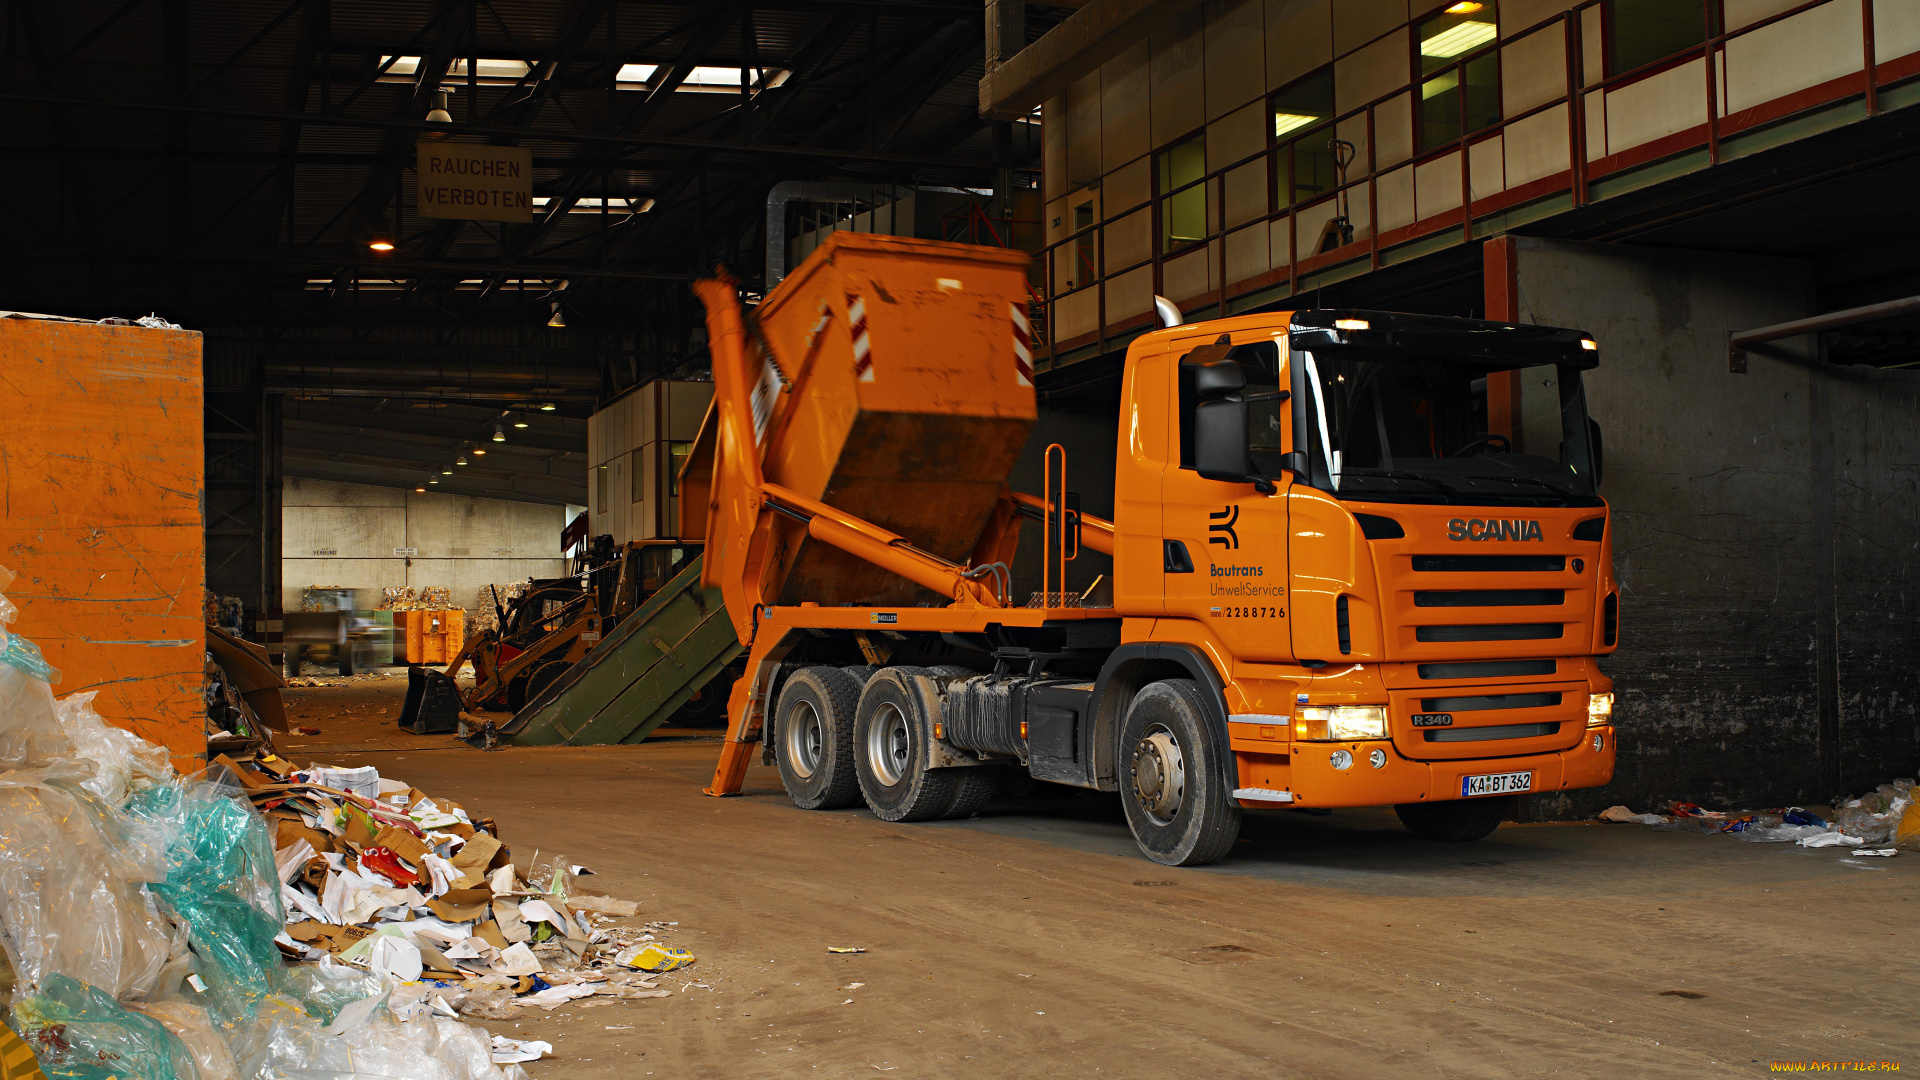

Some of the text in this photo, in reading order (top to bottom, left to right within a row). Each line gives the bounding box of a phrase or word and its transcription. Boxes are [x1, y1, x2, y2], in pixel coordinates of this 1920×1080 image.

[430, 156, 520, 178] RAUCHEN
[424, 186, 527, 209] VERBOTEN
[1446, 518, 1544, 542] SCANIA
[1210, 563, 1264, 577] Bautrans
[1210, 581, 1285, 597] UmweltService
[1414, 714, 1452, 726] R 340
[1469, 777, 1485, 793] KA
[1492, 775, 1508, 791] BT
[1509, 773, 1530, 790] 362
